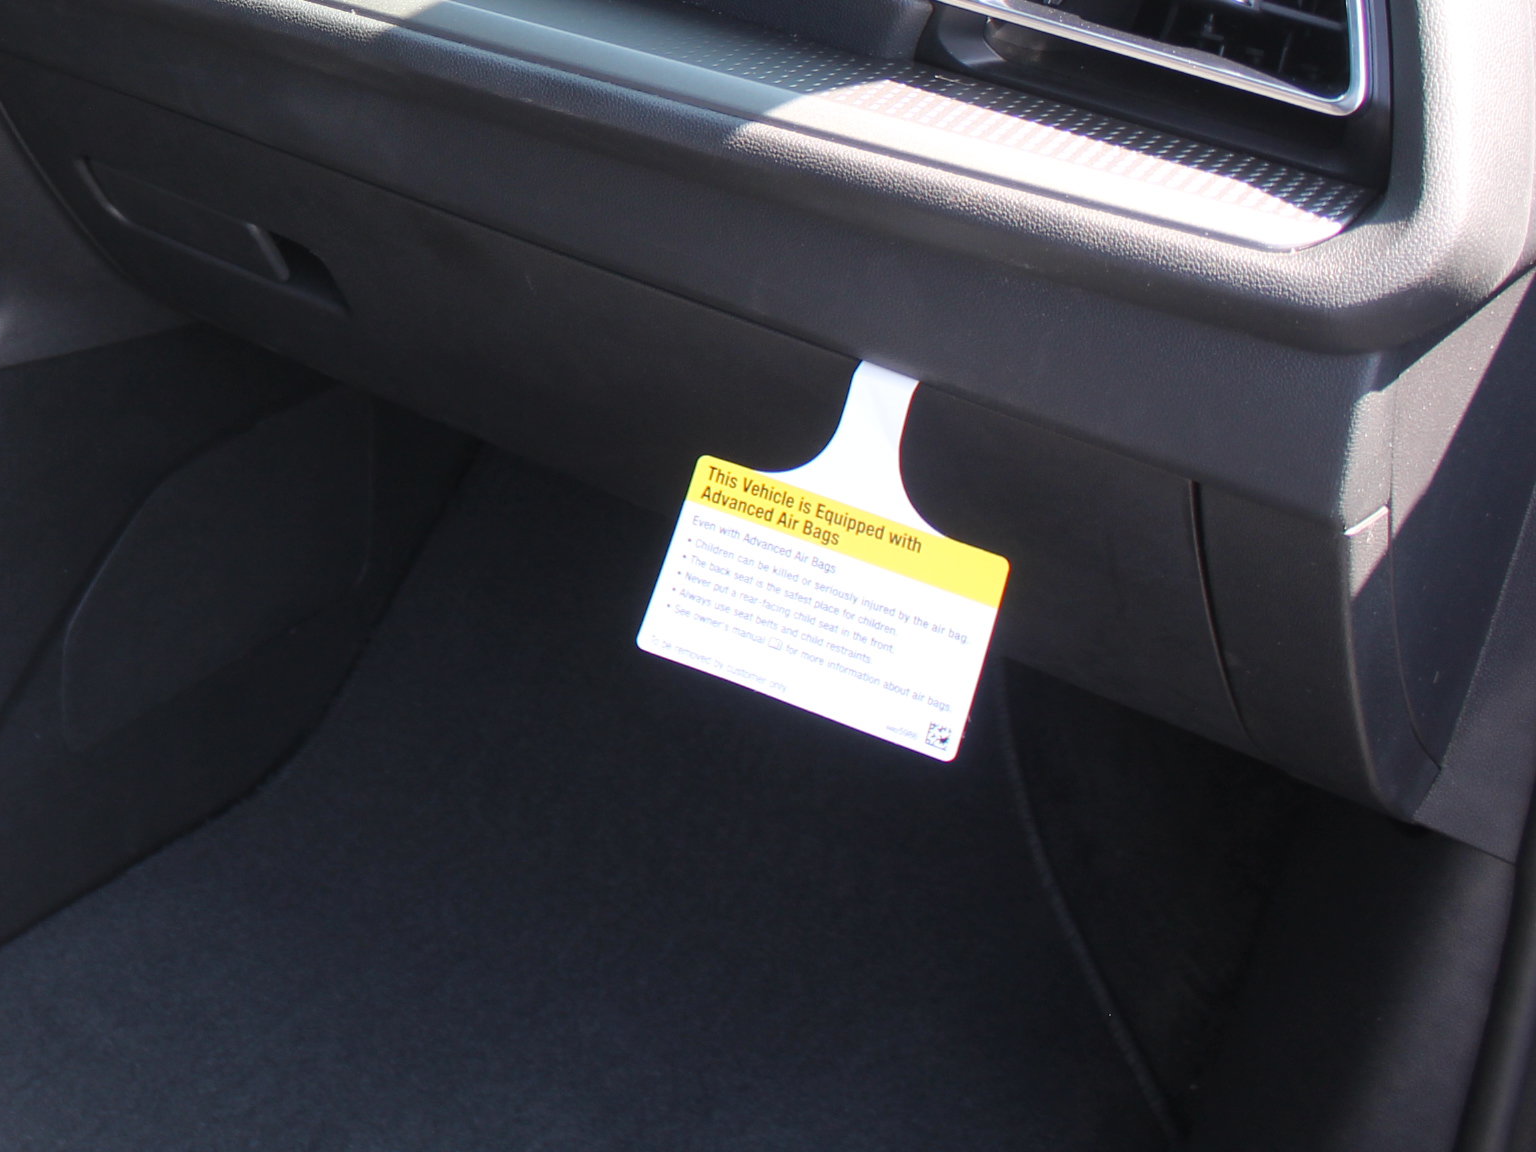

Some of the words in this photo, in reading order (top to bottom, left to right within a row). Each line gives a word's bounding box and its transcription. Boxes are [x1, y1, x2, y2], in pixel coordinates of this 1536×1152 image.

[691, 514, 717, 532] Even
[719, 526, 741, 540] with
[742, 532, 793, 559] Advanced
[793, 550, 810, 564] Air
[810, 555, 837, 575] Bags
[699, 484, 775, 523] Advanced
[775, 510, 799, 531] Air
[801, 518, 840, 547] Bags
[708, 464, 738, 490] This
[742, 476, 795, 510] Vehicle
[797, 496, 812, 516] is
[814, 502, 885, 541] Equipped
[888, 531, 922, 554] with
[695, 538, 736, 560] Children
[736, 554, 756, 567] can
[757, 560, 771, 573] be
[772, 565, 801, 583] killed
[801, 577, 813, 587] or
[814, 581, 859, 605] seriously
[860, 598, 897, 617] injured
[897, 610, 911, 624] by
[913, 615, 930, 630] the
[931, 623, 946, 635] air
